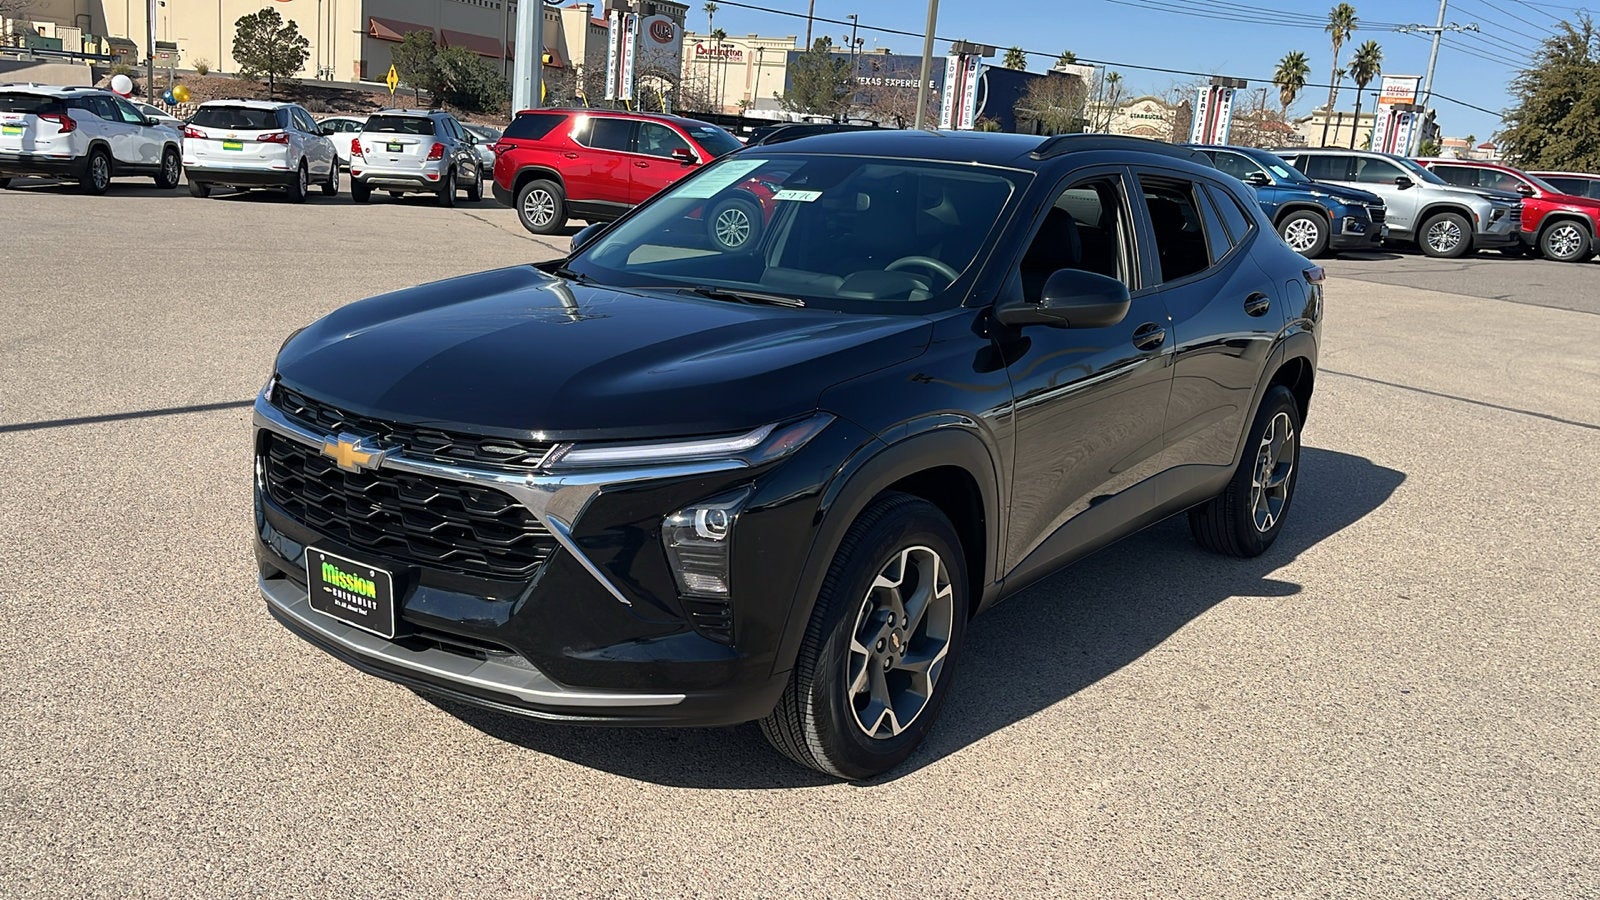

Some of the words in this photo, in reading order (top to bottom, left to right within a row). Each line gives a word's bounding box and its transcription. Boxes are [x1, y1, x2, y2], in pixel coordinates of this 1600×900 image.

[696, 43, 743, 57] Burlington
[947, 59, 955, 79] LOW
[968, 58, 977, 79] LOW
[943, 85, 953, 125] PRICES
[963, 85, 974, 125] PRICES
[322, 562, 376, 598] Mission
[333, 588, 377, 610] CHEVROLET
